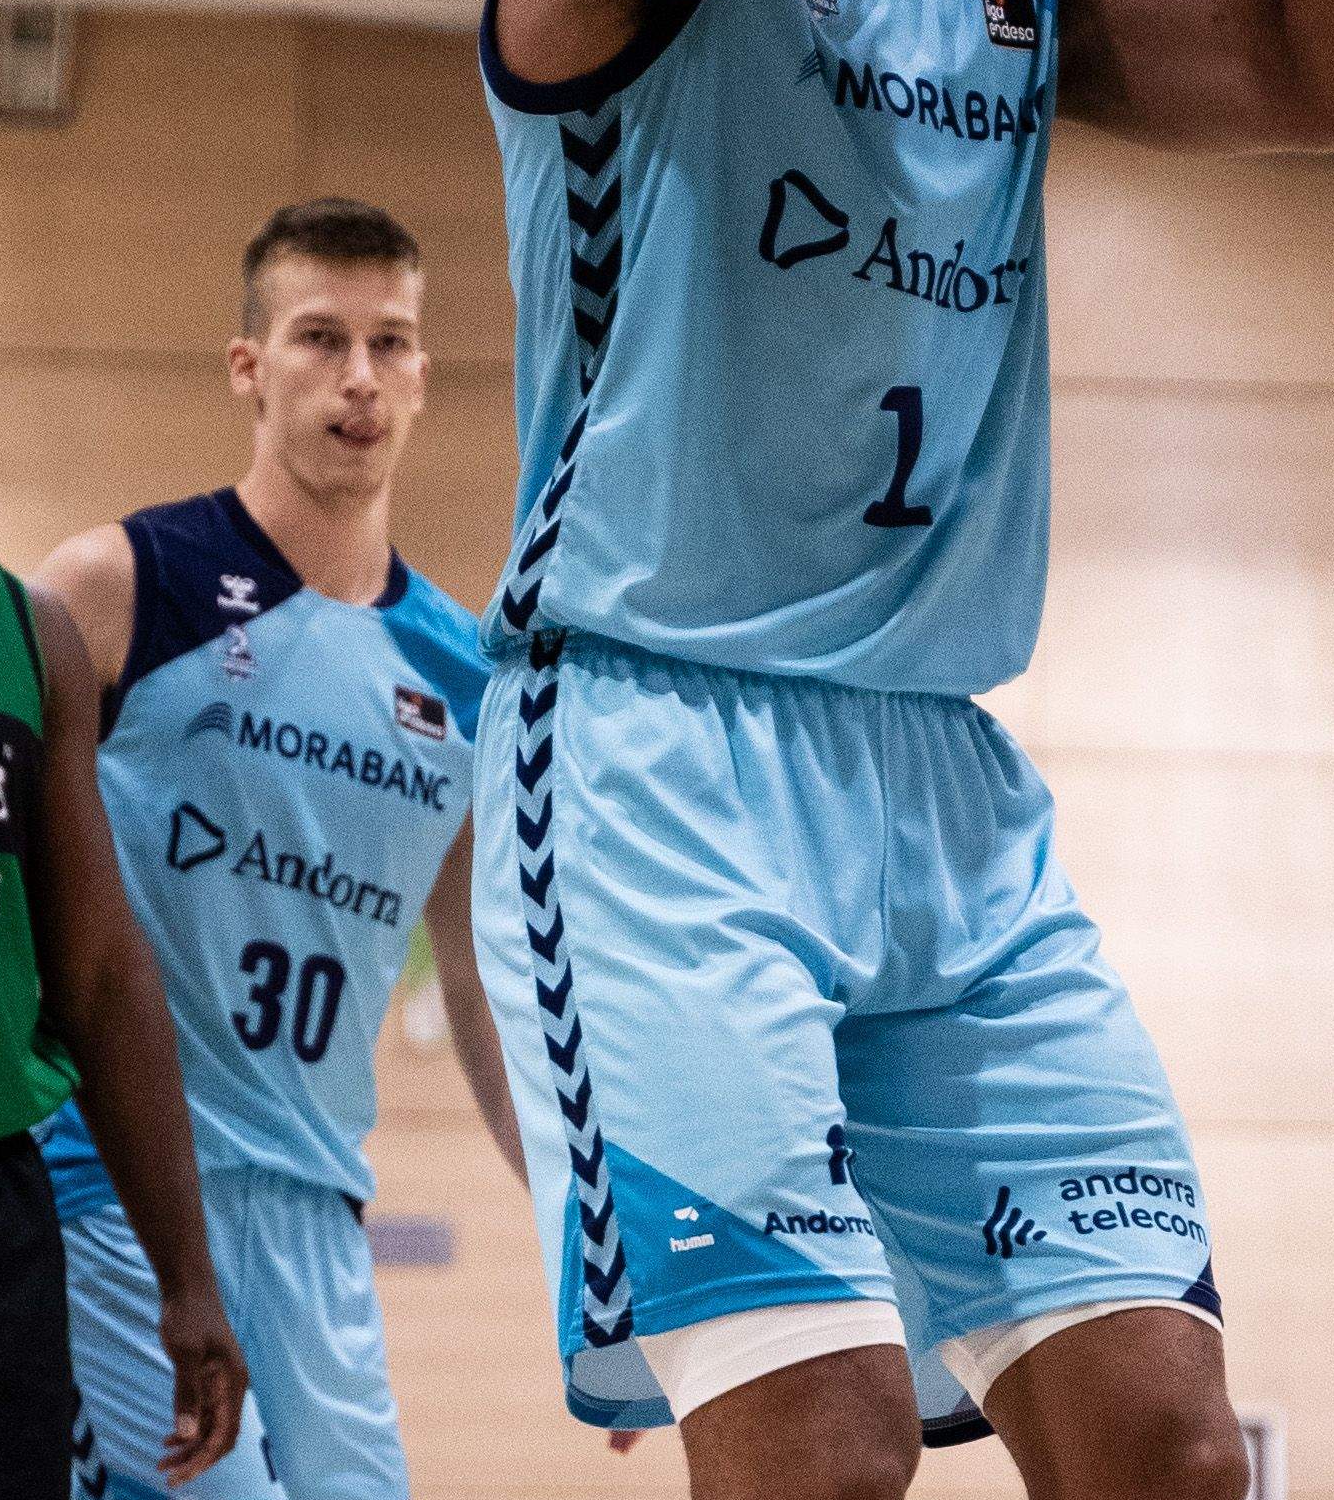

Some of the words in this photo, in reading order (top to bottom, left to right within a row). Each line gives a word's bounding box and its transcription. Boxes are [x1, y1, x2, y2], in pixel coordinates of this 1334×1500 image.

[988, 21, 1035, 41] endesa
[851, 216, 1028, 313] Andor
[862, 386, 933, 528] 1
[237, 711, 452, 812] MORABANC
[232, 938, 346, 1066] 30
[1058, 1165, 1196, 1208] andorra
[1068, 1201, 1208, 1247] telecom
